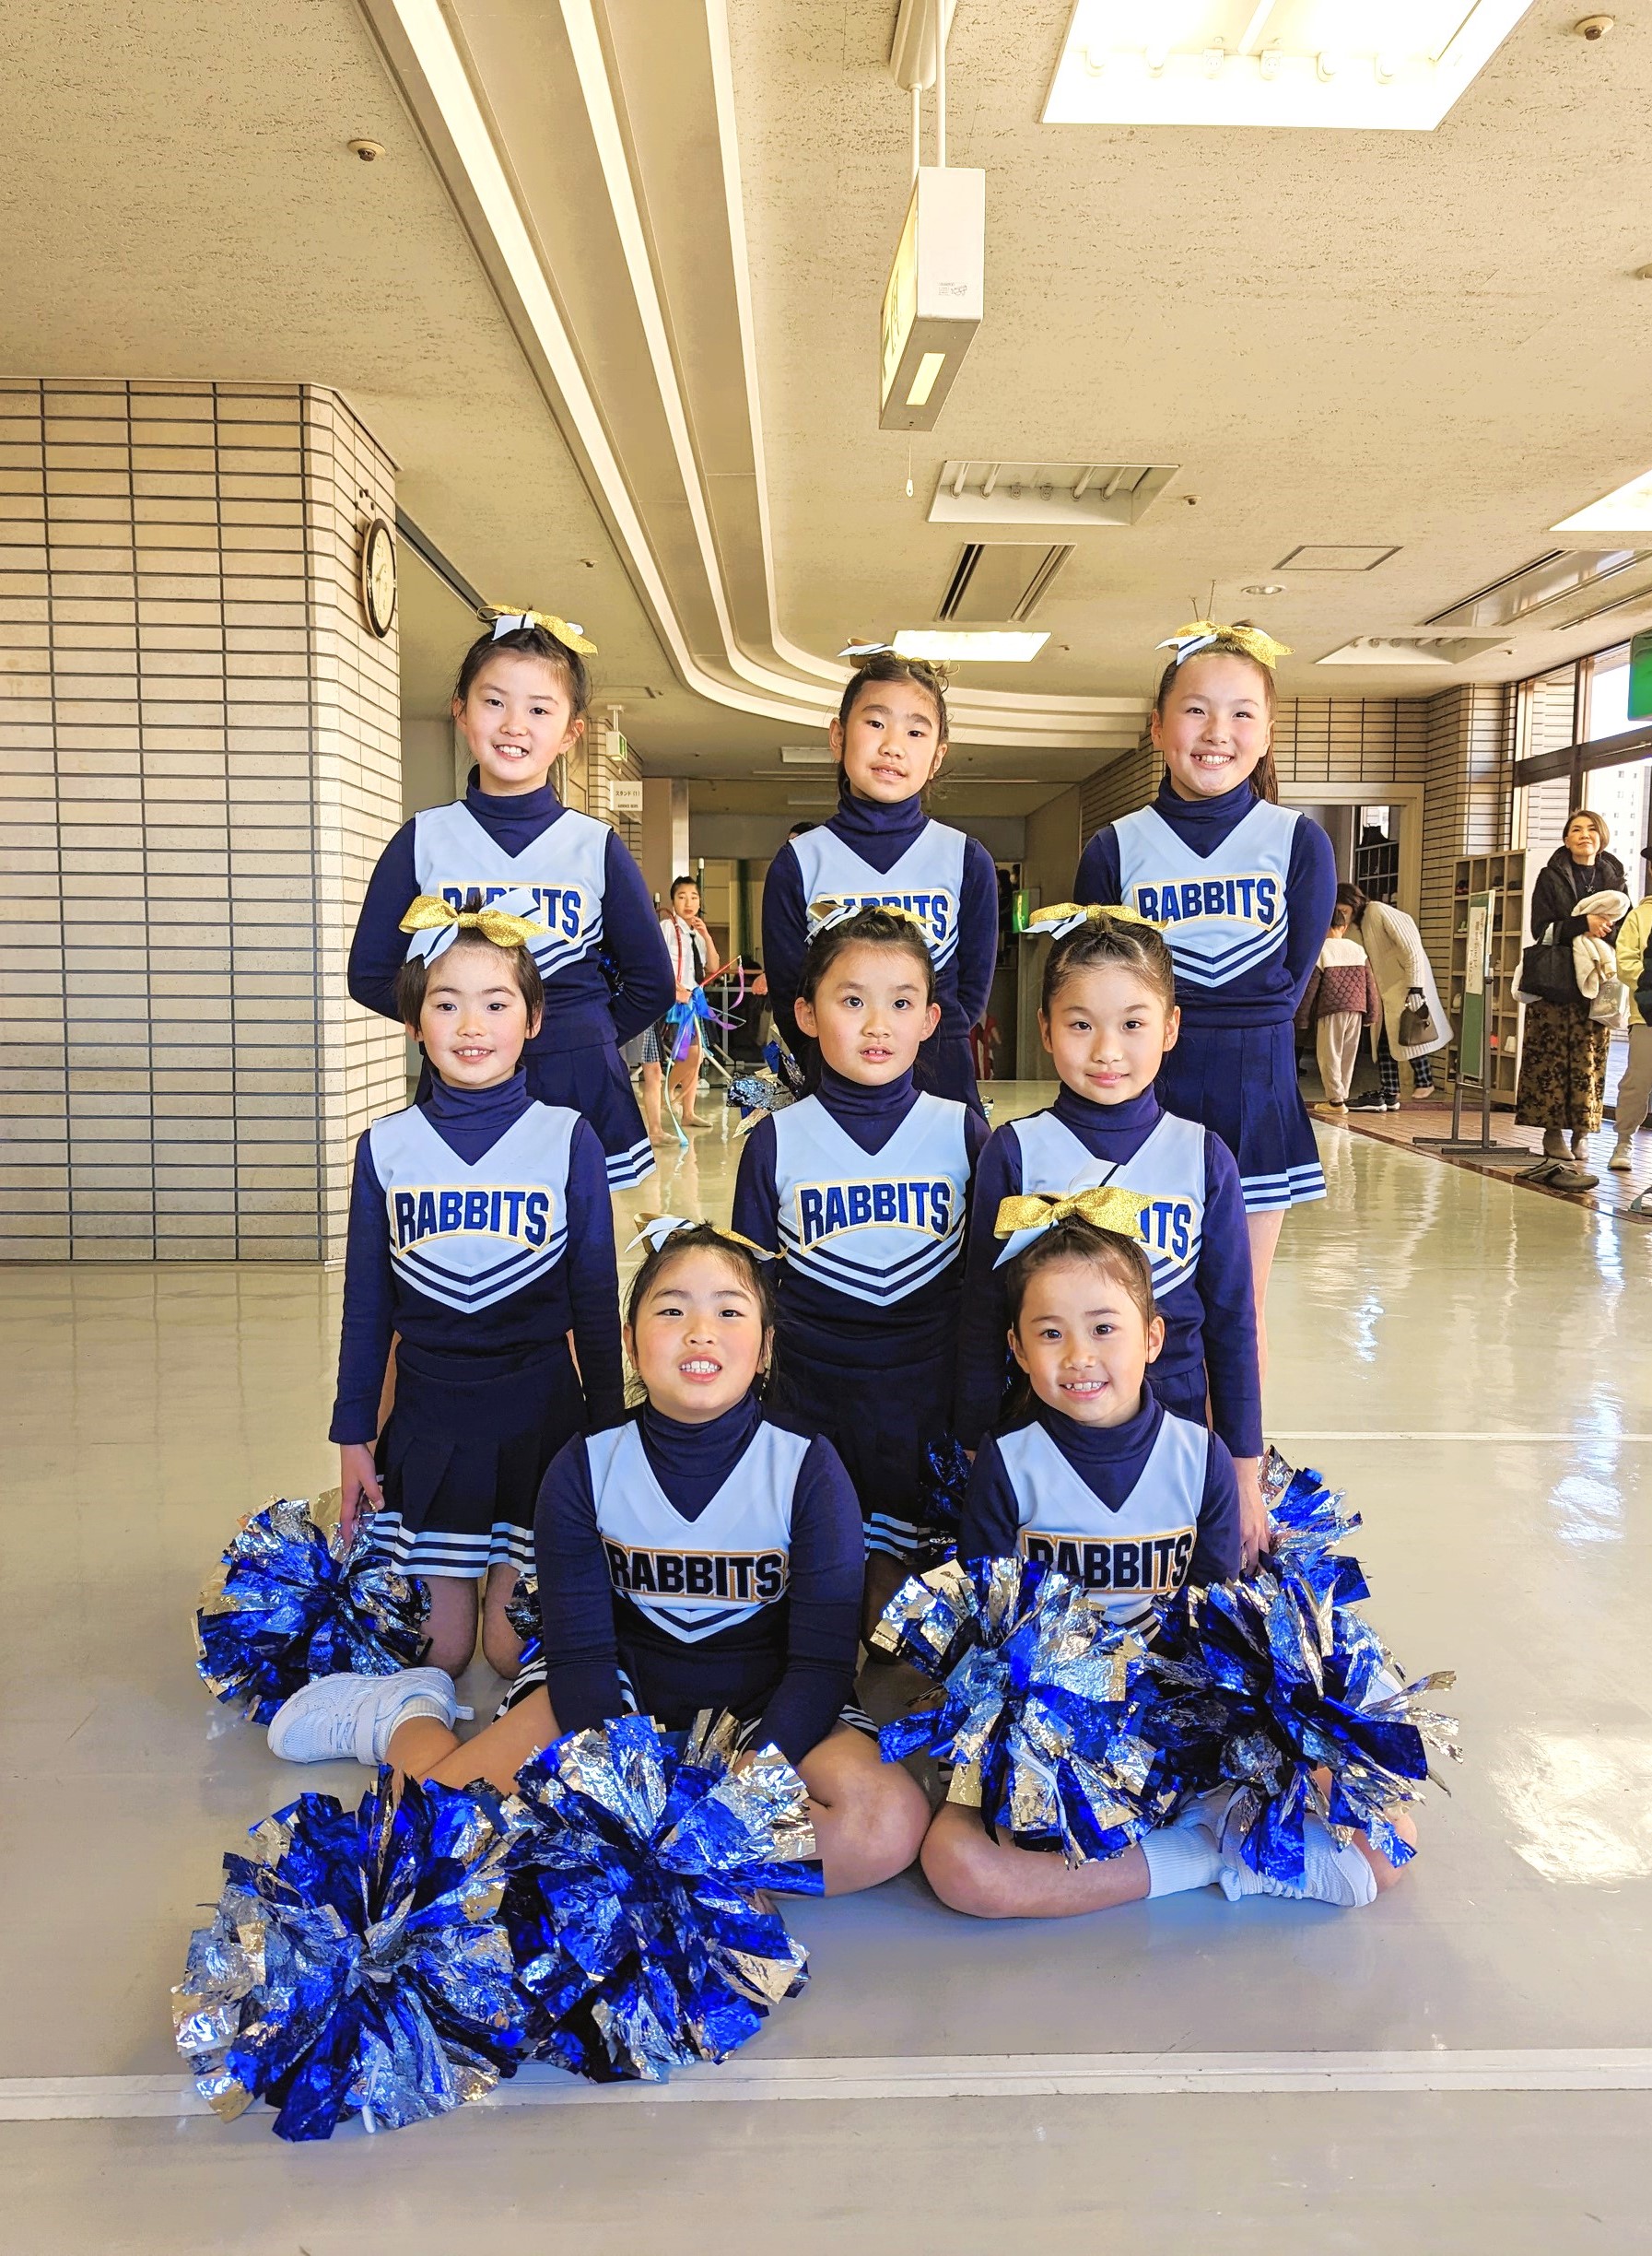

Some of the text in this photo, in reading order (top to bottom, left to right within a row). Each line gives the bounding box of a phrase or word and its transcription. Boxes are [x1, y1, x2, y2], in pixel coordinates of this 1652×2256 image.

[1137, 877, 1277, 925] RABBITS
[394, 1191, 550, 1250] RABBITS
[800, 1181, 952, 1246] RABBITS
[603, 1540, 784, 1599] RABBITS
